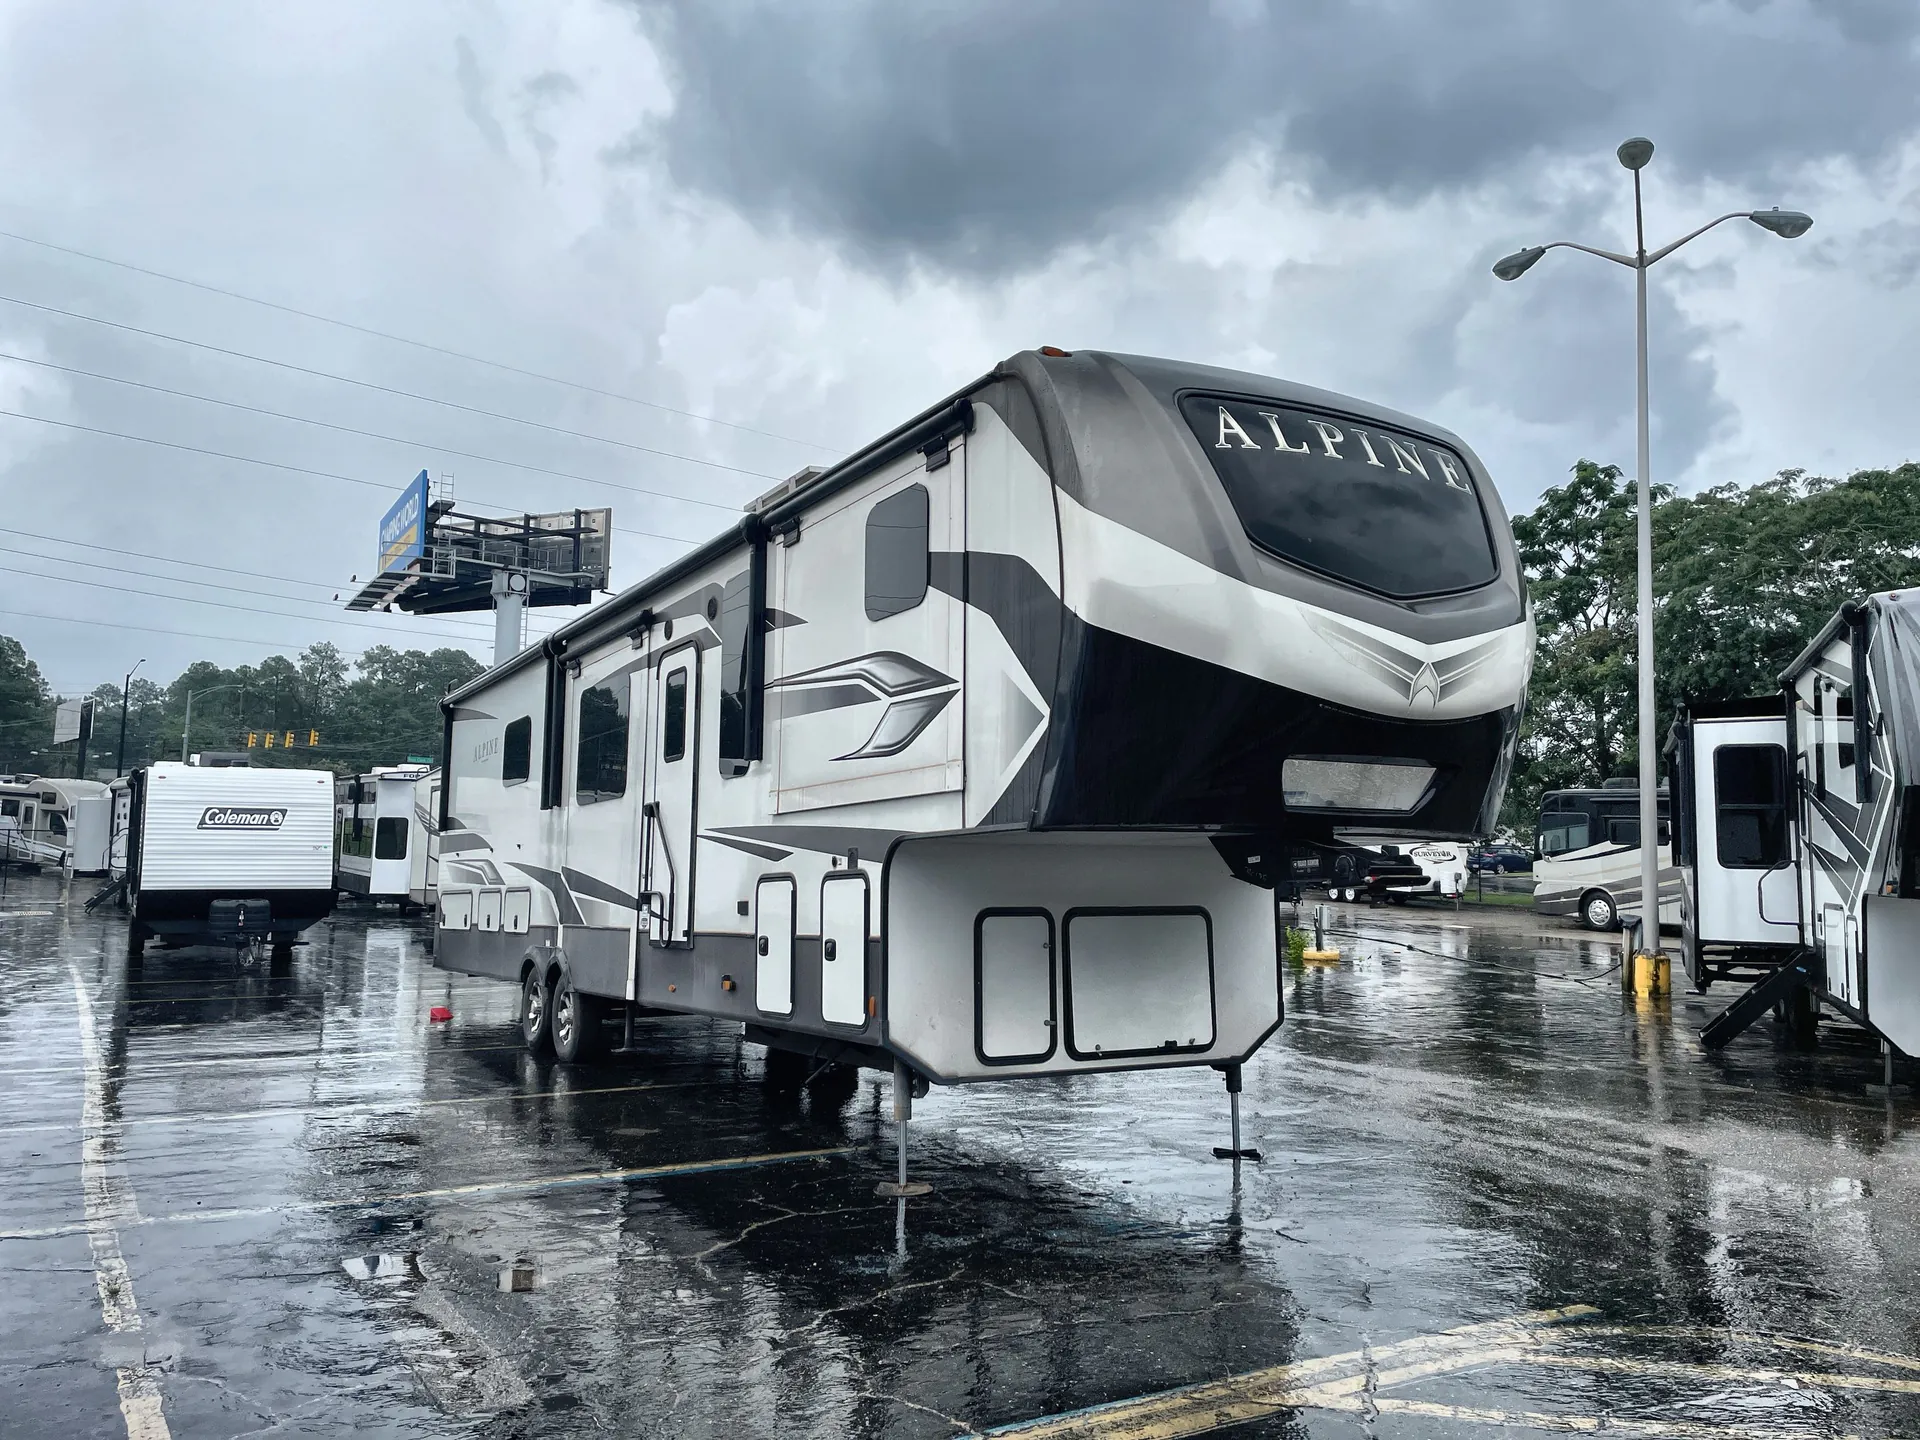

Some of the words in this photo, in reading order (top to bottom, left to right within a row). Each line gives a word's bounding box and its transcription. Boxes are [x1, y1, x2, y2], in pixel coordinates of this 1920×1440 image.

[1215, 405, 1472, 495] ALPINE
[473, 737, 498, 762] ALPINE
[204, 808, 269, 825] Coleman
